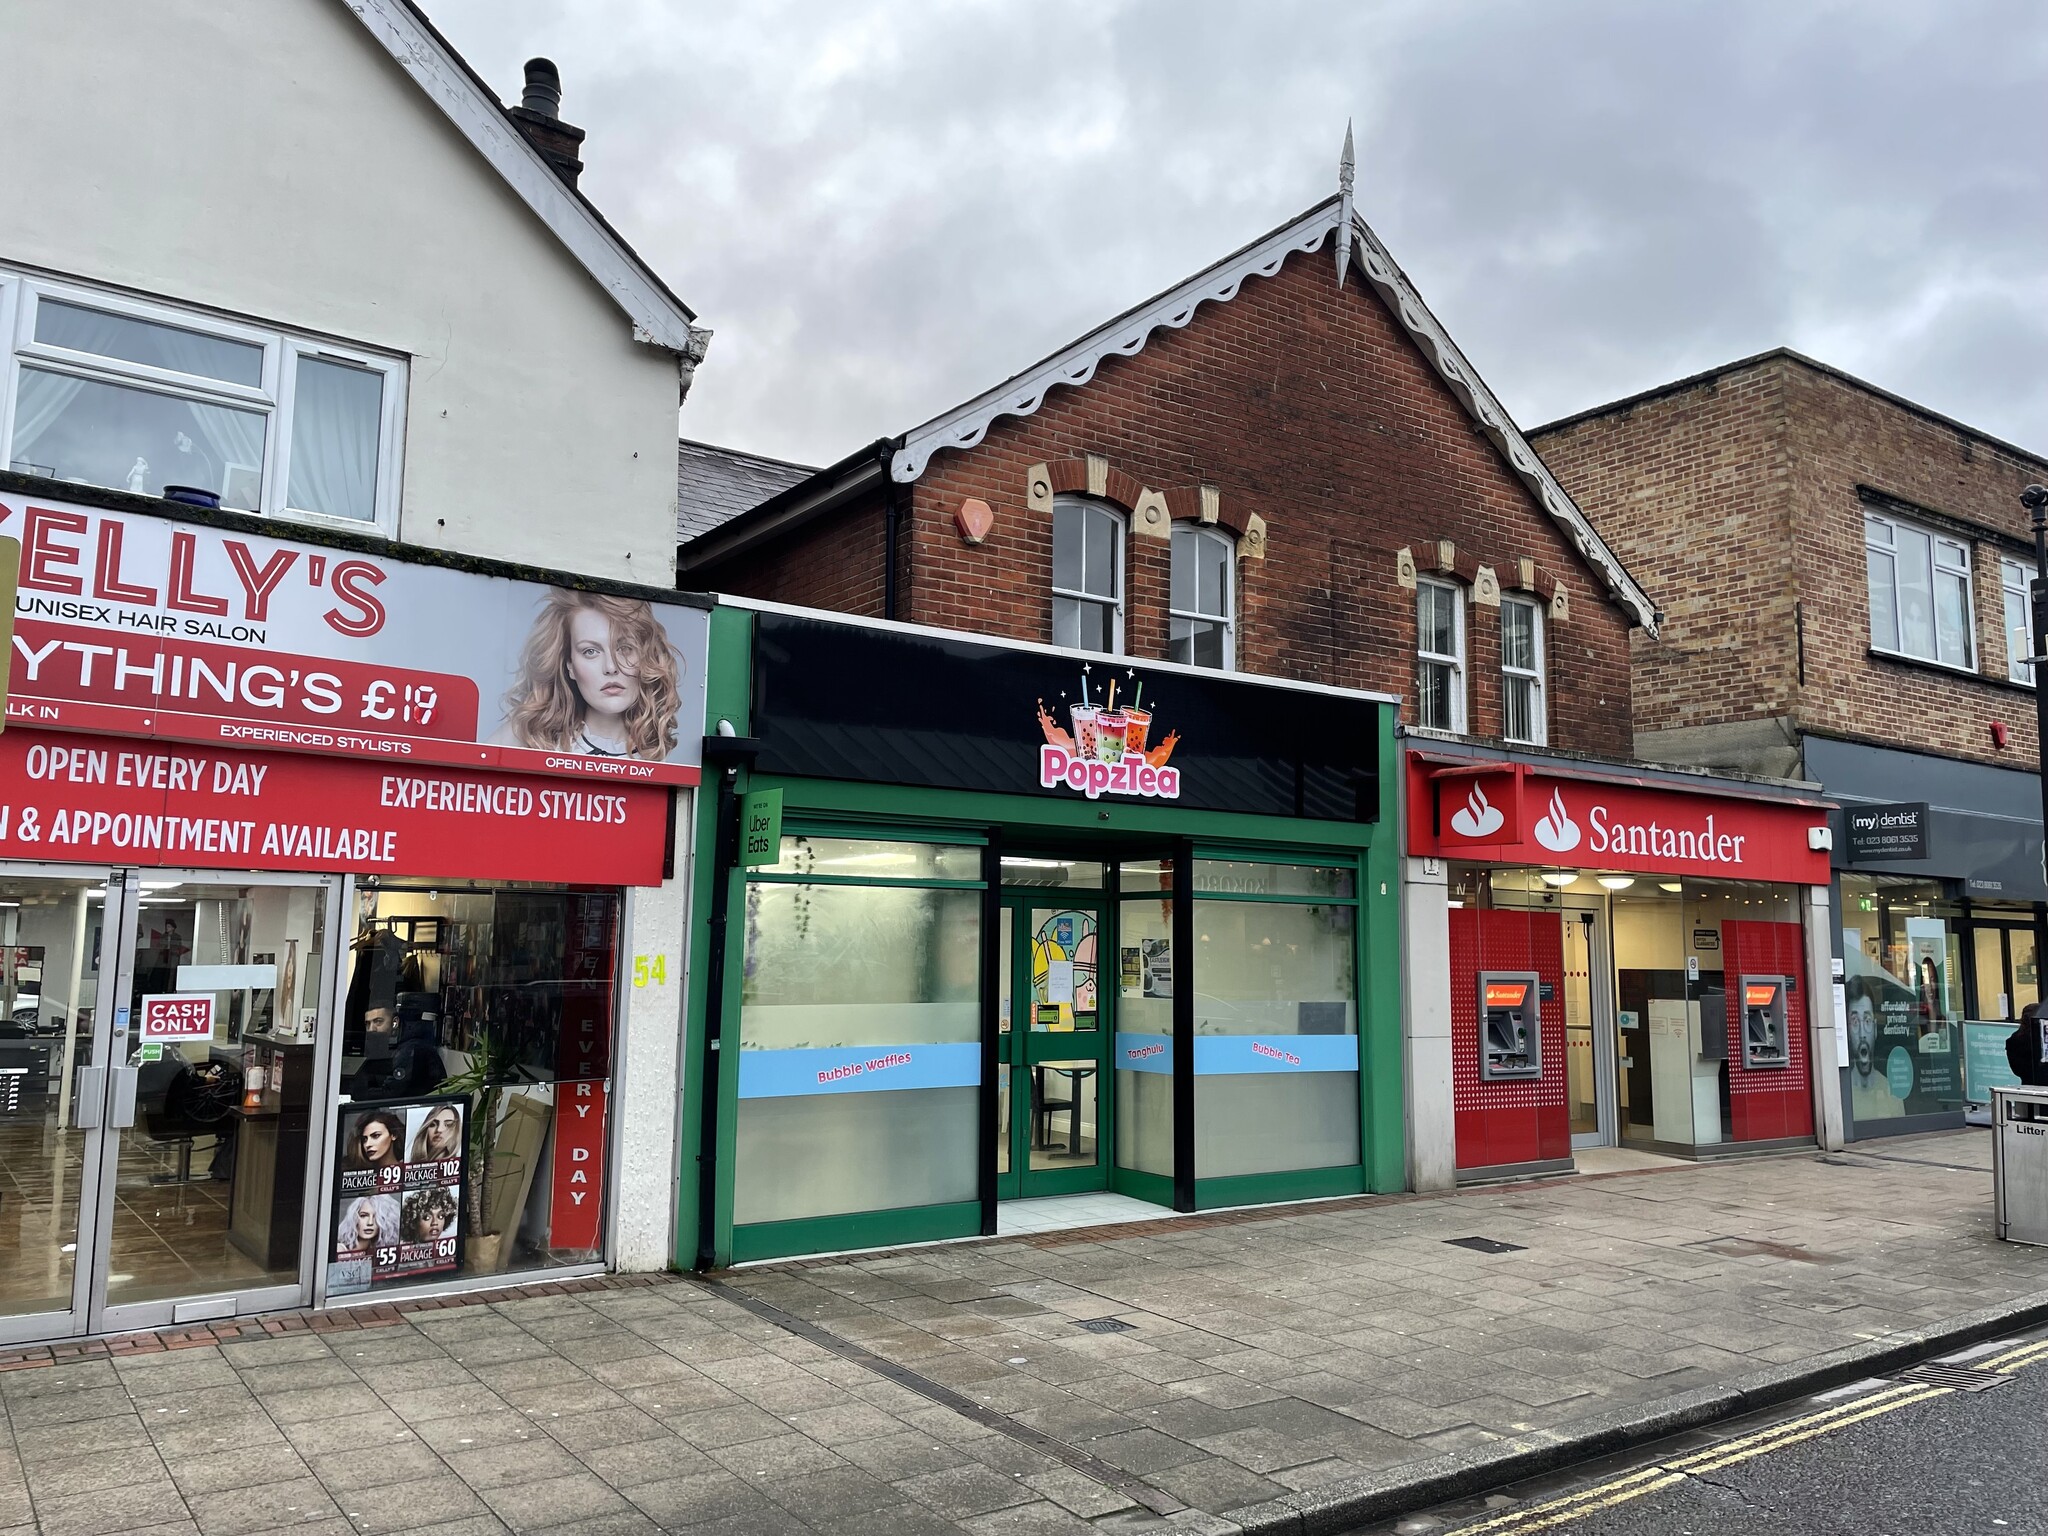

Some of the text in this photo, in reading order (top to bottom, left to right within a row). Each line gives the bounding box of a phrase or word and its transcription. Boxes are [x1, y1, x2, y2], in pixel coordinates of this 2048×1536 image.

[0, 502, 388, 638] ELLY'S
[15, 595, 267, 644] UNISEX HAIR SALON
[12, 635, 343, 714] YTHING'S
[40, 706, 59, 719] IN
[220, 724, 412, 755] EXPERIENCED STYLISTS
[26, 744, 268, 796] OPEN EVERY DAY
[545, 757, 655, 777] OPEN EVERY DAY
[1042, 748, 1179, 796] PopzTea
[381, 776, 627, 824] EXPERIENCED STYLISTS
[749, 815, 771, 832] Uber
[17, 806, 41, 842] &
[49, 809, 256, 854] APPOINTMENT
[261, 823, 397, 862] AVAILABLE
[1589, 805, 1745, 863] Santander
[1866, 836, 1880, 845] 023
[1899, 834, 1919, 843] 3535
[748, 836, 769, 853] Eats
[633, 954, 667, 988] 54
[151, 1003, 207, 1018] CASH
[1880, 1001, 1910, 1012] affordable
[150, 1018, 207, 1032] ONLY
[1886, 1013, 1908, 1026] private
[1883, 1024, 1910, 1037] dentistry
[1127, 1044, 1164, 1060] Tanghulu
[1252, 1042, 1300, 1065] Bubble Tea
[818, 1053, 911, 1083] Bubble Waffles
[2016, 1124, 2045, 1136] Litter
[380, 1166, 401, 1185] £99
[405, 1169, 438, 1182] PACKAGE
[440, 1160, 460, 1177] £102
[570, 1147, 590, 1206] DAY
[341, 1175, 377, 1189] PACKAGE
[376, 1247, 397, 1266] £55
[400, 1249, 433, 1262] PACKAGE
[436, 1238, 456, 1257] £60
